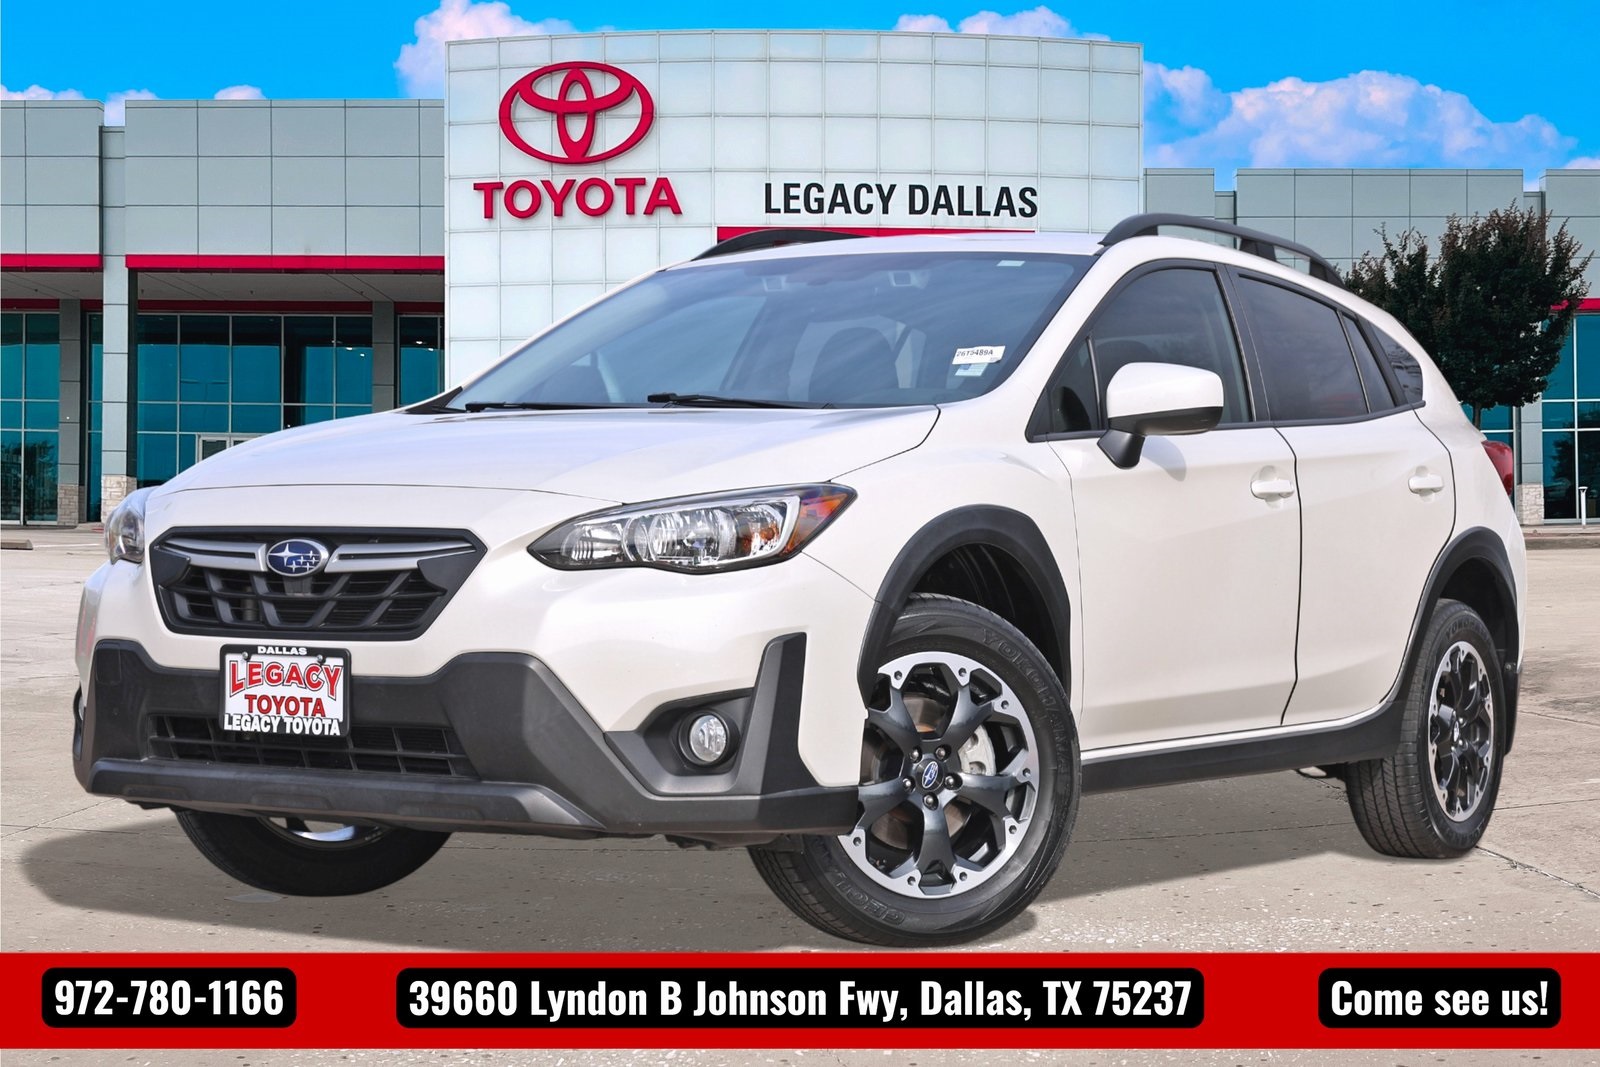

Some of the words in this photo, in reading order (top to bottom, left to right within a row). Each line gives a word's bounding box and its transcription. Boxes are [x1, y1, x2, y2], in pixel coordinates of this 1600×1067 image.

[474, 177, 681, 219] TOYOTA
[764, 183, 897, 215] LEGACY
[908, 184, 1038, 218] DALLAS
[257, 645, 308, 656] DALLAS
[229, 660, 344, 702] LEGACY
[244, 694, 327, 718] TOYOTA
[223, 713, 283, 734] LEGACY
[284, 716, 341, 737] TOYOTA
